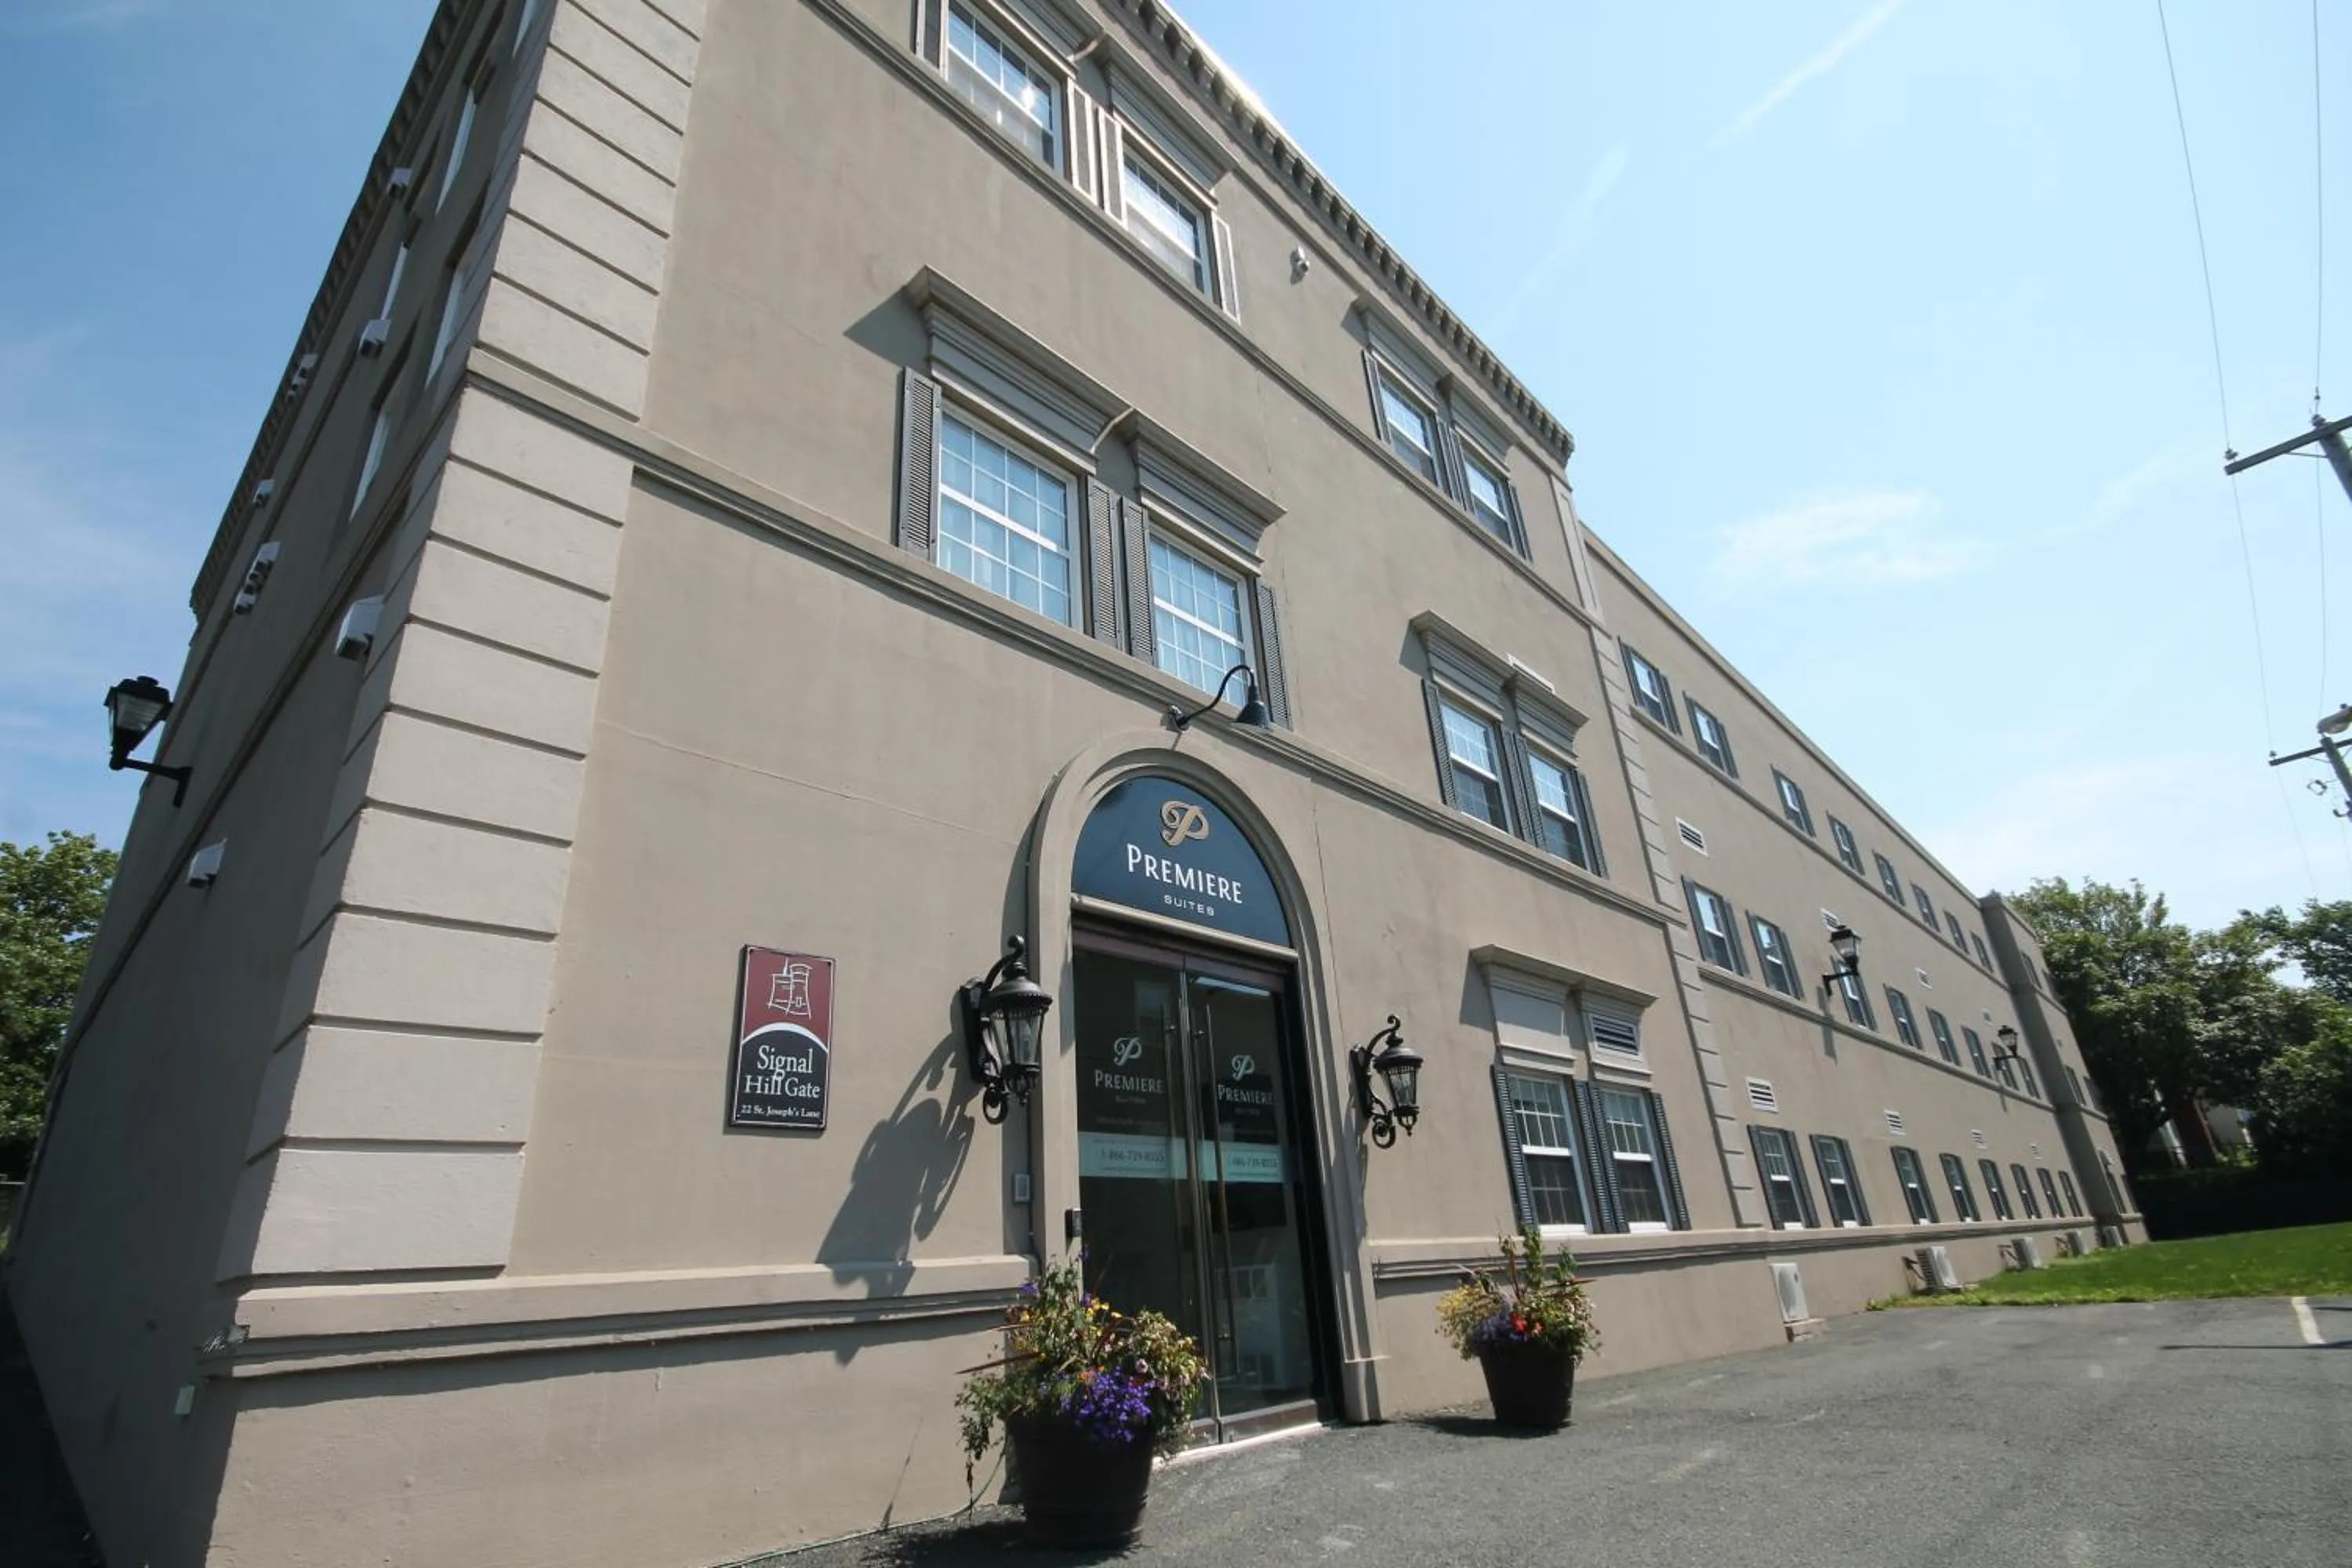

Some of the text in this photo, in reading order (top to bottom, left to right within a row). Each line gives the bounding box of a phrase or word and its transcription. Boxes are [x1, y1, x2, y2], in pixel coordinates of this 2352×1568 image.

[1127, 843, 1243, 904] PREMIERE
[1163, 894, 1214, 916] SUITES
[757, 1045, 813, 1080] Signal
[744, 1075, 821, 1098] Hill Gate
[1094, 1069, 1167, 1094] PREMIERE
[1218, 1083, 1275, 1105] PREMIERE
[741, 1104, 753, 1114] 22
[766, 1105, 800, 1117] Joseph's
[800, 1107, 821, 1118] Lane
